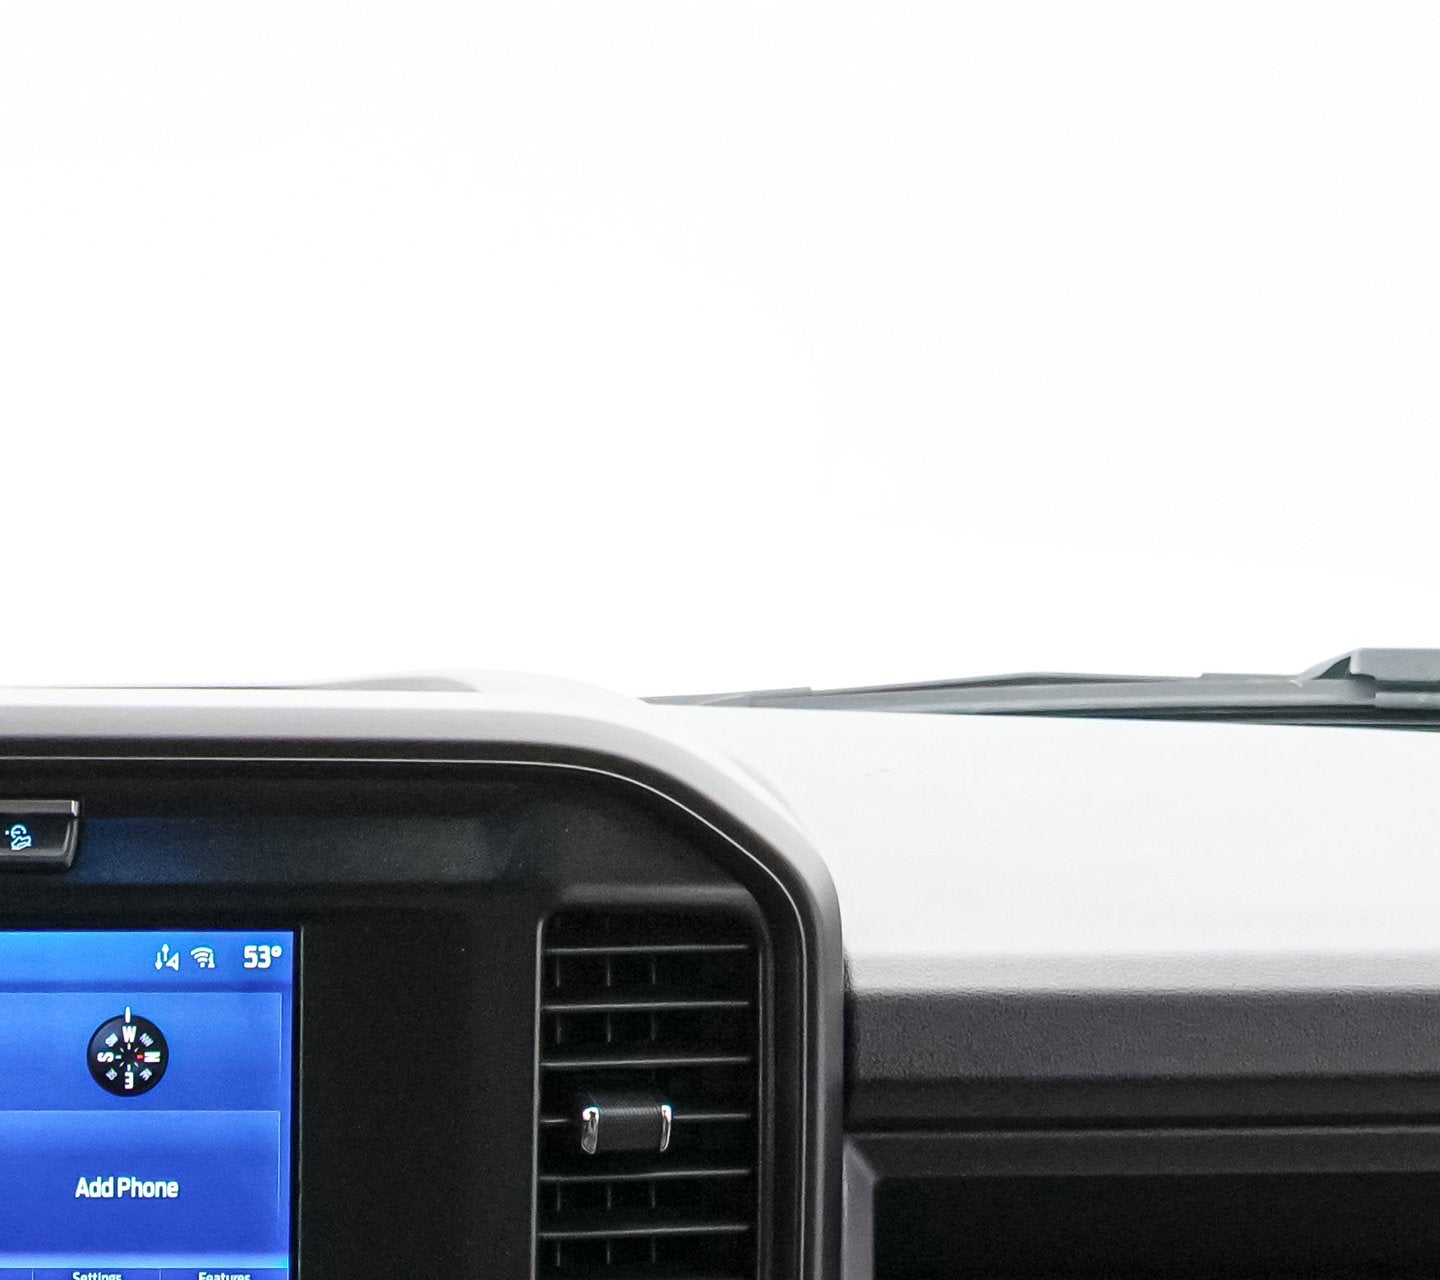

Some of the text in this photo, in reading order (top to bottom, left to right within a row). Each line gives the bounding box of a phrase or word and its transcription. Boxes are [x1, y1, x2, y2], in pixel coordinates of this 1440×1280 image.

[243, 945, 283, 970] 53°
[122, 1026, 137, 1042] W
[97, 1052, 114, 1062] S
[144, 1052, 161, 1062] N
[125, 1072, 134, 1089] E
[74, 1177, 179, 1198] Add Phone
